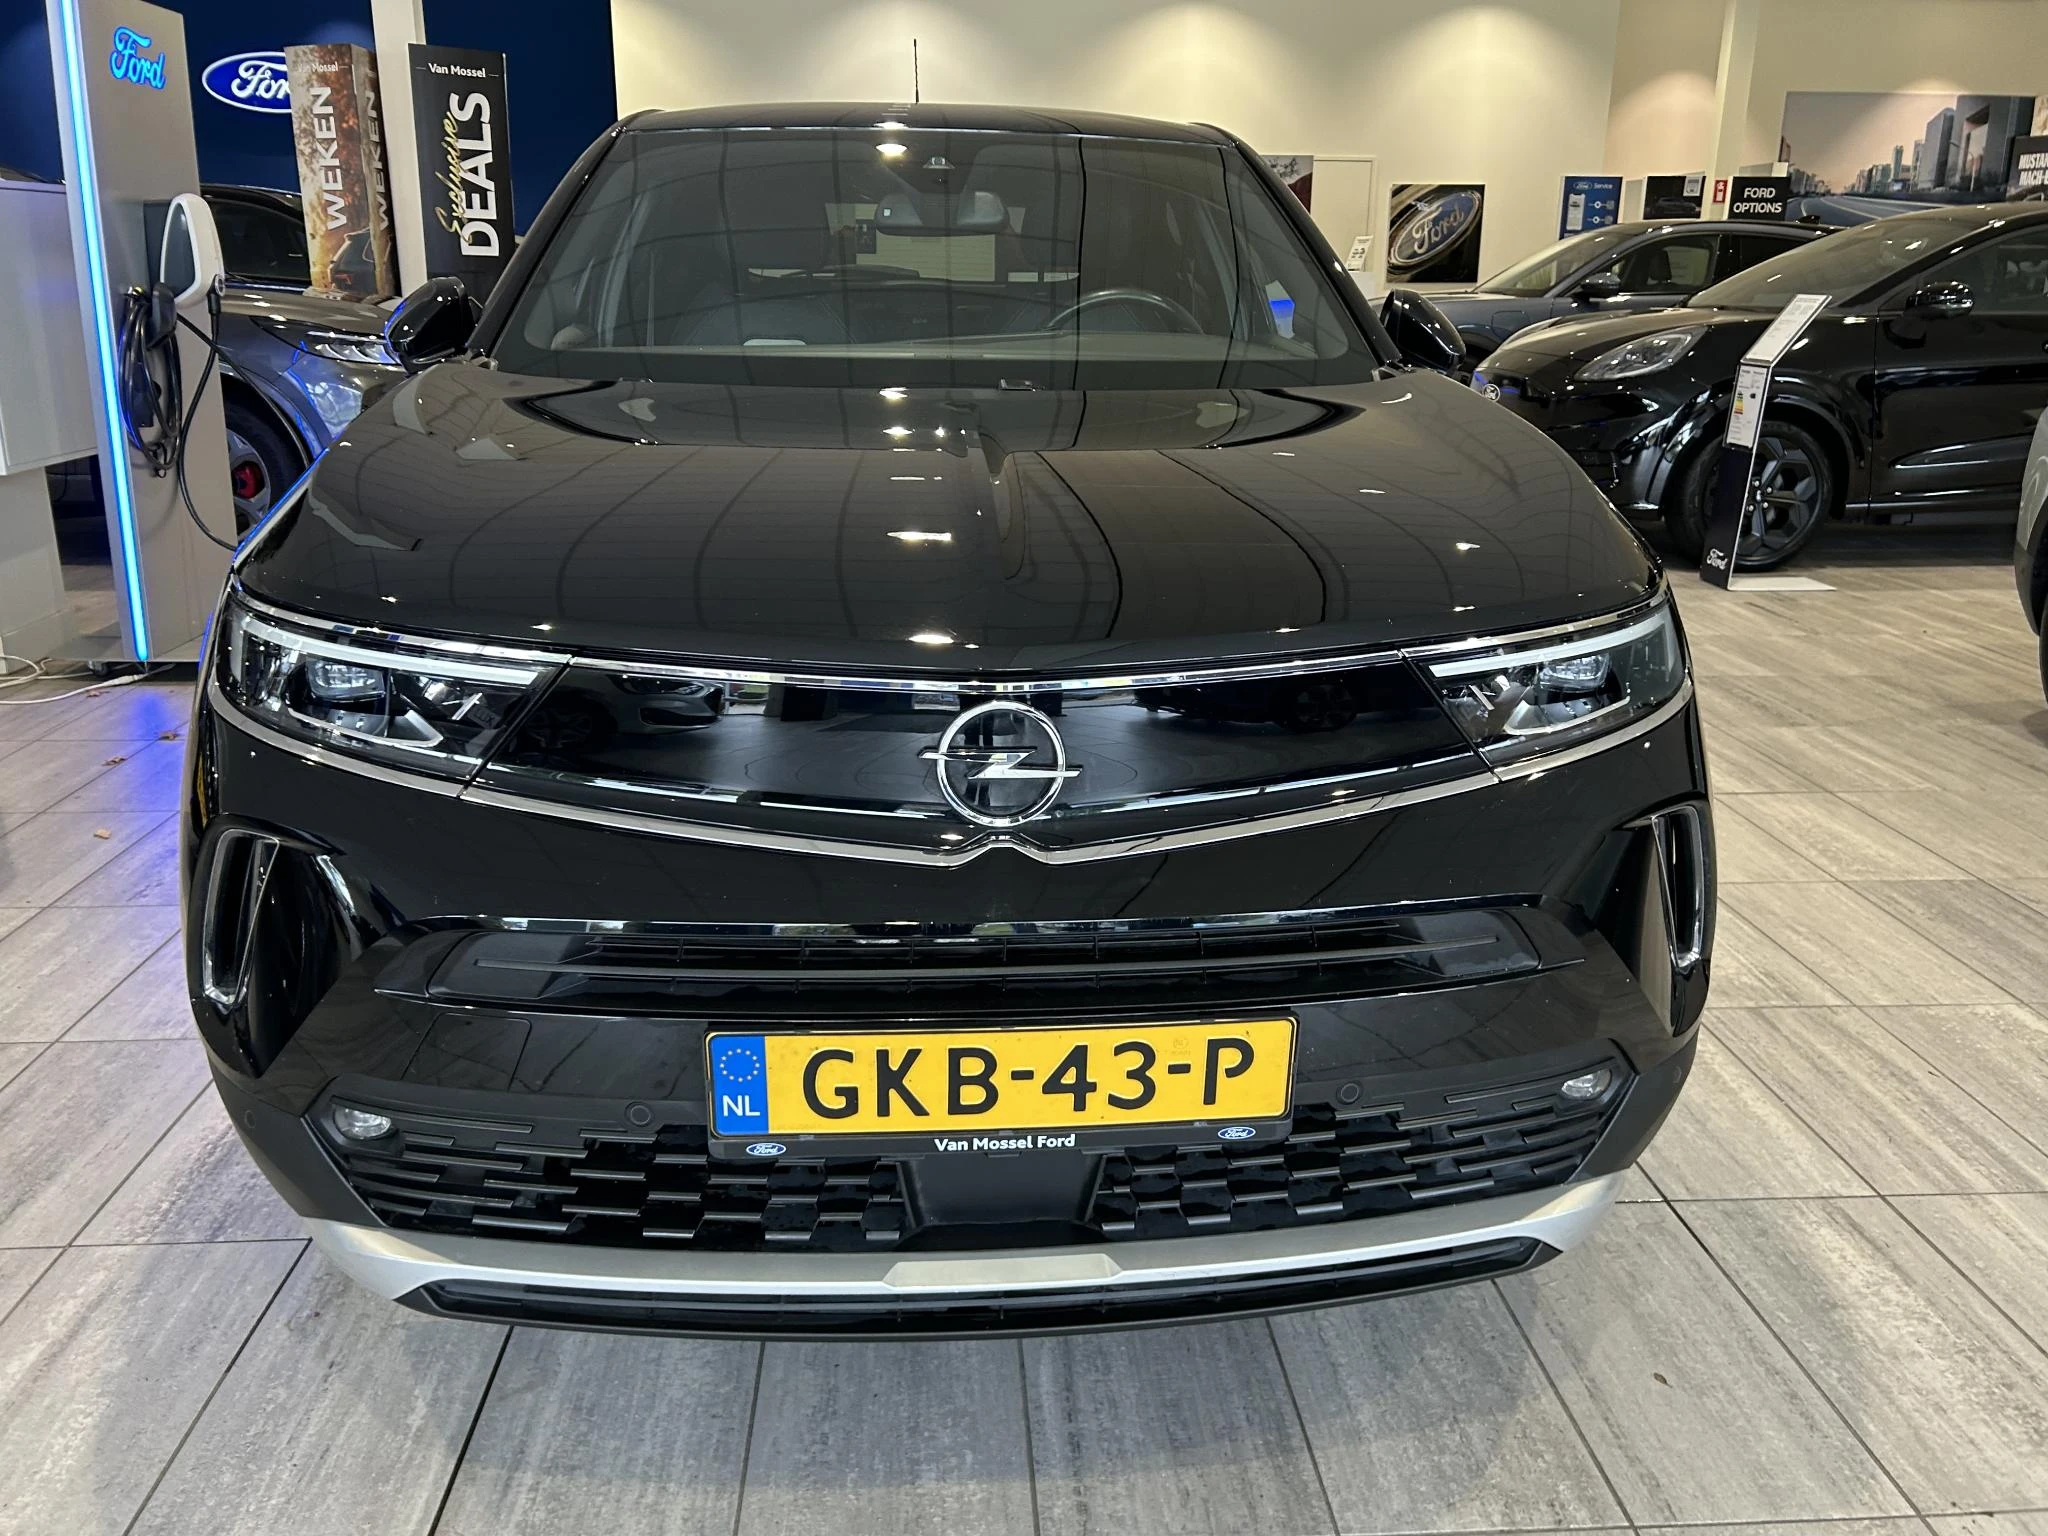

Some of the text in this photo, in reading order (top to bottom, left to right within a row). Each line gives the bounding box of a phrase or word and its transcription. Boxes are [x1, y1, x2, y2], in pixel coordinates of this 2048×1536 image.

[110, 26, 166, 89] Ford
[312, 60, 338, 73] Mossel
[428, 62, 486, 78] Van Mossel
[230, 60, 291, 99] For
[309, 87, 347, 230] WEKEN
[365, 91, 389, 231] WEKEN
[434, 112, 473, 244] Exclusive
[450, 92, 500, 257] DEALS
[1593, 182, 1613, 190] Service
[1733, 202, 1783, 213] OPTIONS
[1743, 187, 1776, 199] FORD
[1412, 201, 1465, 254] Ford
[1706, 548, 1728, 570] Ford
[802, 1037, 1255, 1119] GKB-43-P
[722, 1094, 761, 1117] NL
[934, 1133, 1076, 1151] Van Mossel Ford
